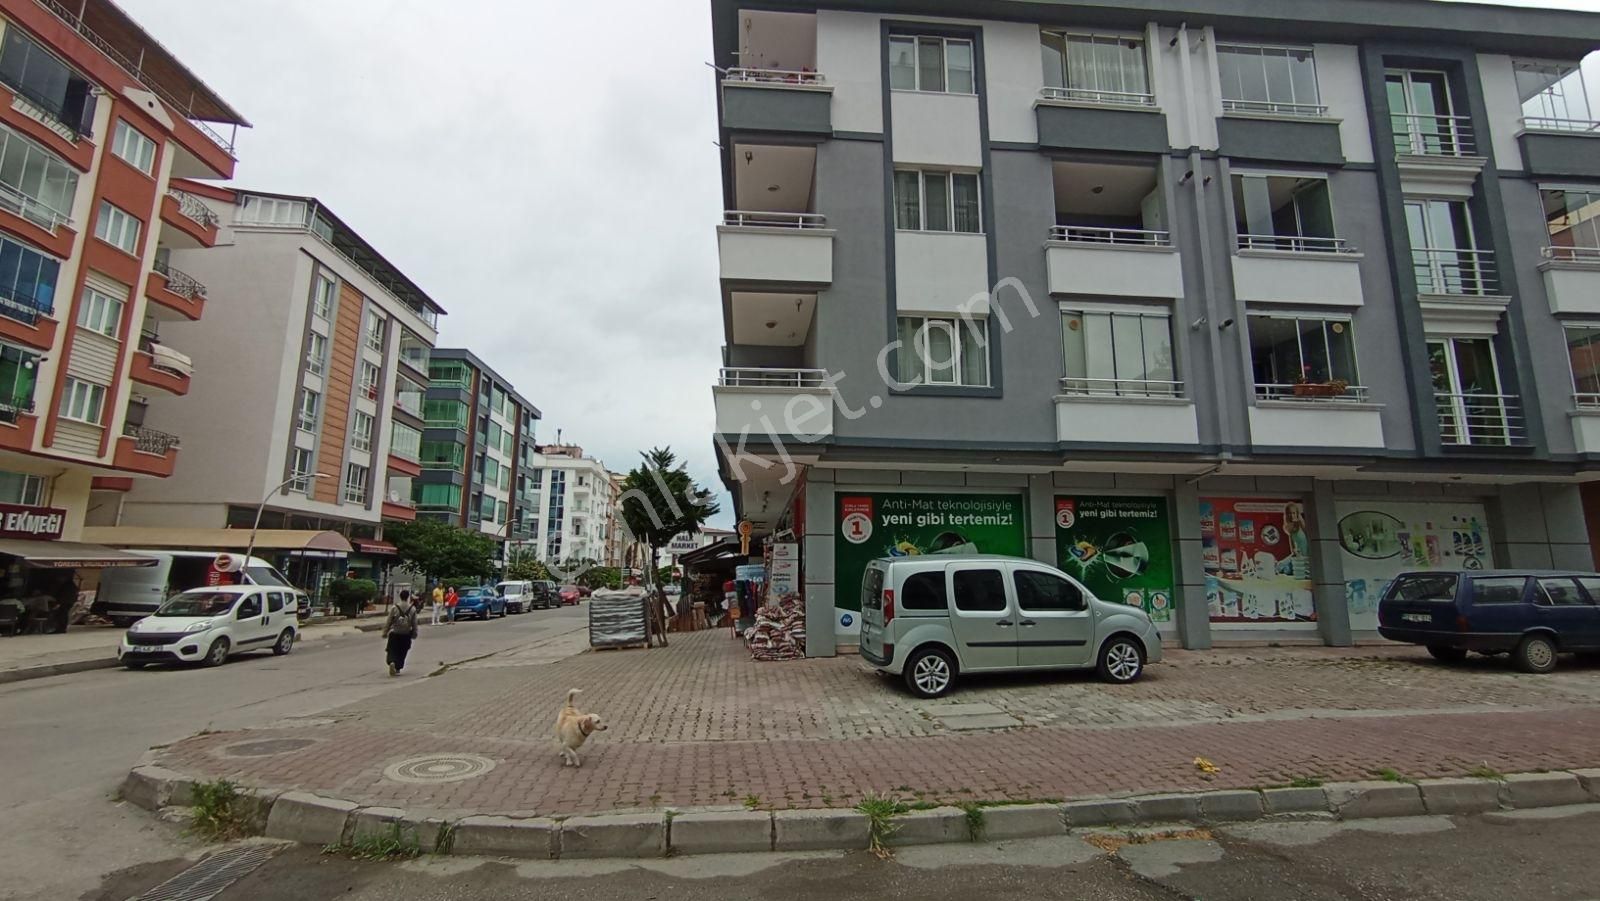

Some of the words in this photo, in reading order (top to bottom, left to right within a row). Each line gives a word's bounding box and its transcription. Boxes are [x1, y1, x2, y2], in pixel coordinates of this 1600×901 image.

[882, 498, 934, 510] Anti-Mat
[937, 498, 1012, 512] teknolojisiyle
[881, 513, 913, 527] yeni
[917, 512, 945, 527] gibi
[948, 513, 1013, 525] tertemiz!
[1062, 514, 1070, 523] 1
[1079, 510, 1098, 518] yeni
[1100, 509, 1117, 519] gibi
[1118, 510, 1158, 518] tertemiz!
[851, 520, 863, 535] 1
